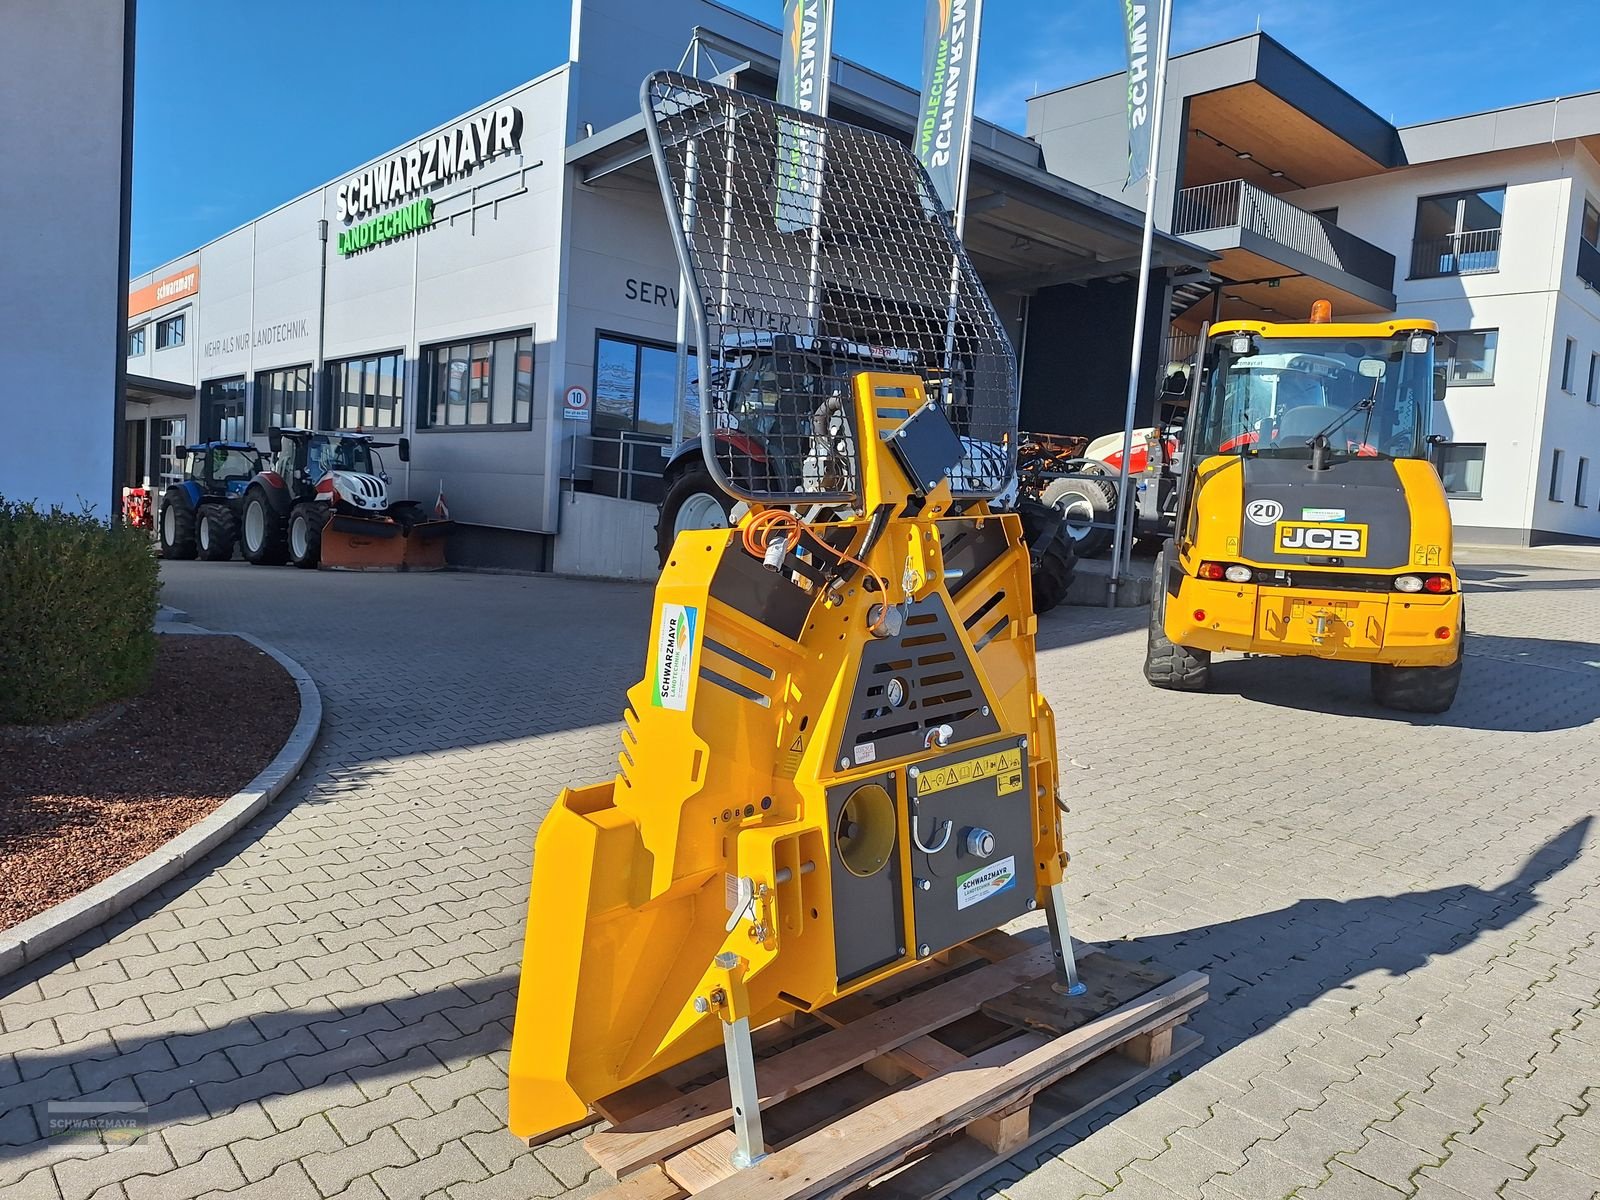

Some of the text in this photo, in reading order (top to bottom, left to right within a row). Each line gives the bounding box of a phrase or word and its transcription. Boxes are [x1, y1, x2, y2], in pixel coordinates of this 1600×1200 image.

[336, 105, 519, 222] SCHWARZMAYR
[336, 197, 433, 256] LANDTECHNIK
[156, 272, 195, 301] schwarzmayr
[625, 278, 791, 333] SERVE ENTER
[204, 341, 221, 358] MEHR
[222, 336, 234, 354] ALS
[235, 333, 250, 351] NUR
[572, 392, 582, 404] 10
[1252, 504, 1276, 518] 20
[1282, 527, 1360, 551] JCB
[661, 618, 677, 698] SCHWARZMAYR
[670, 651, 680, 698] LANDTECHNIK
[962, 866, 1008, 890] SCHWARZMAYR
